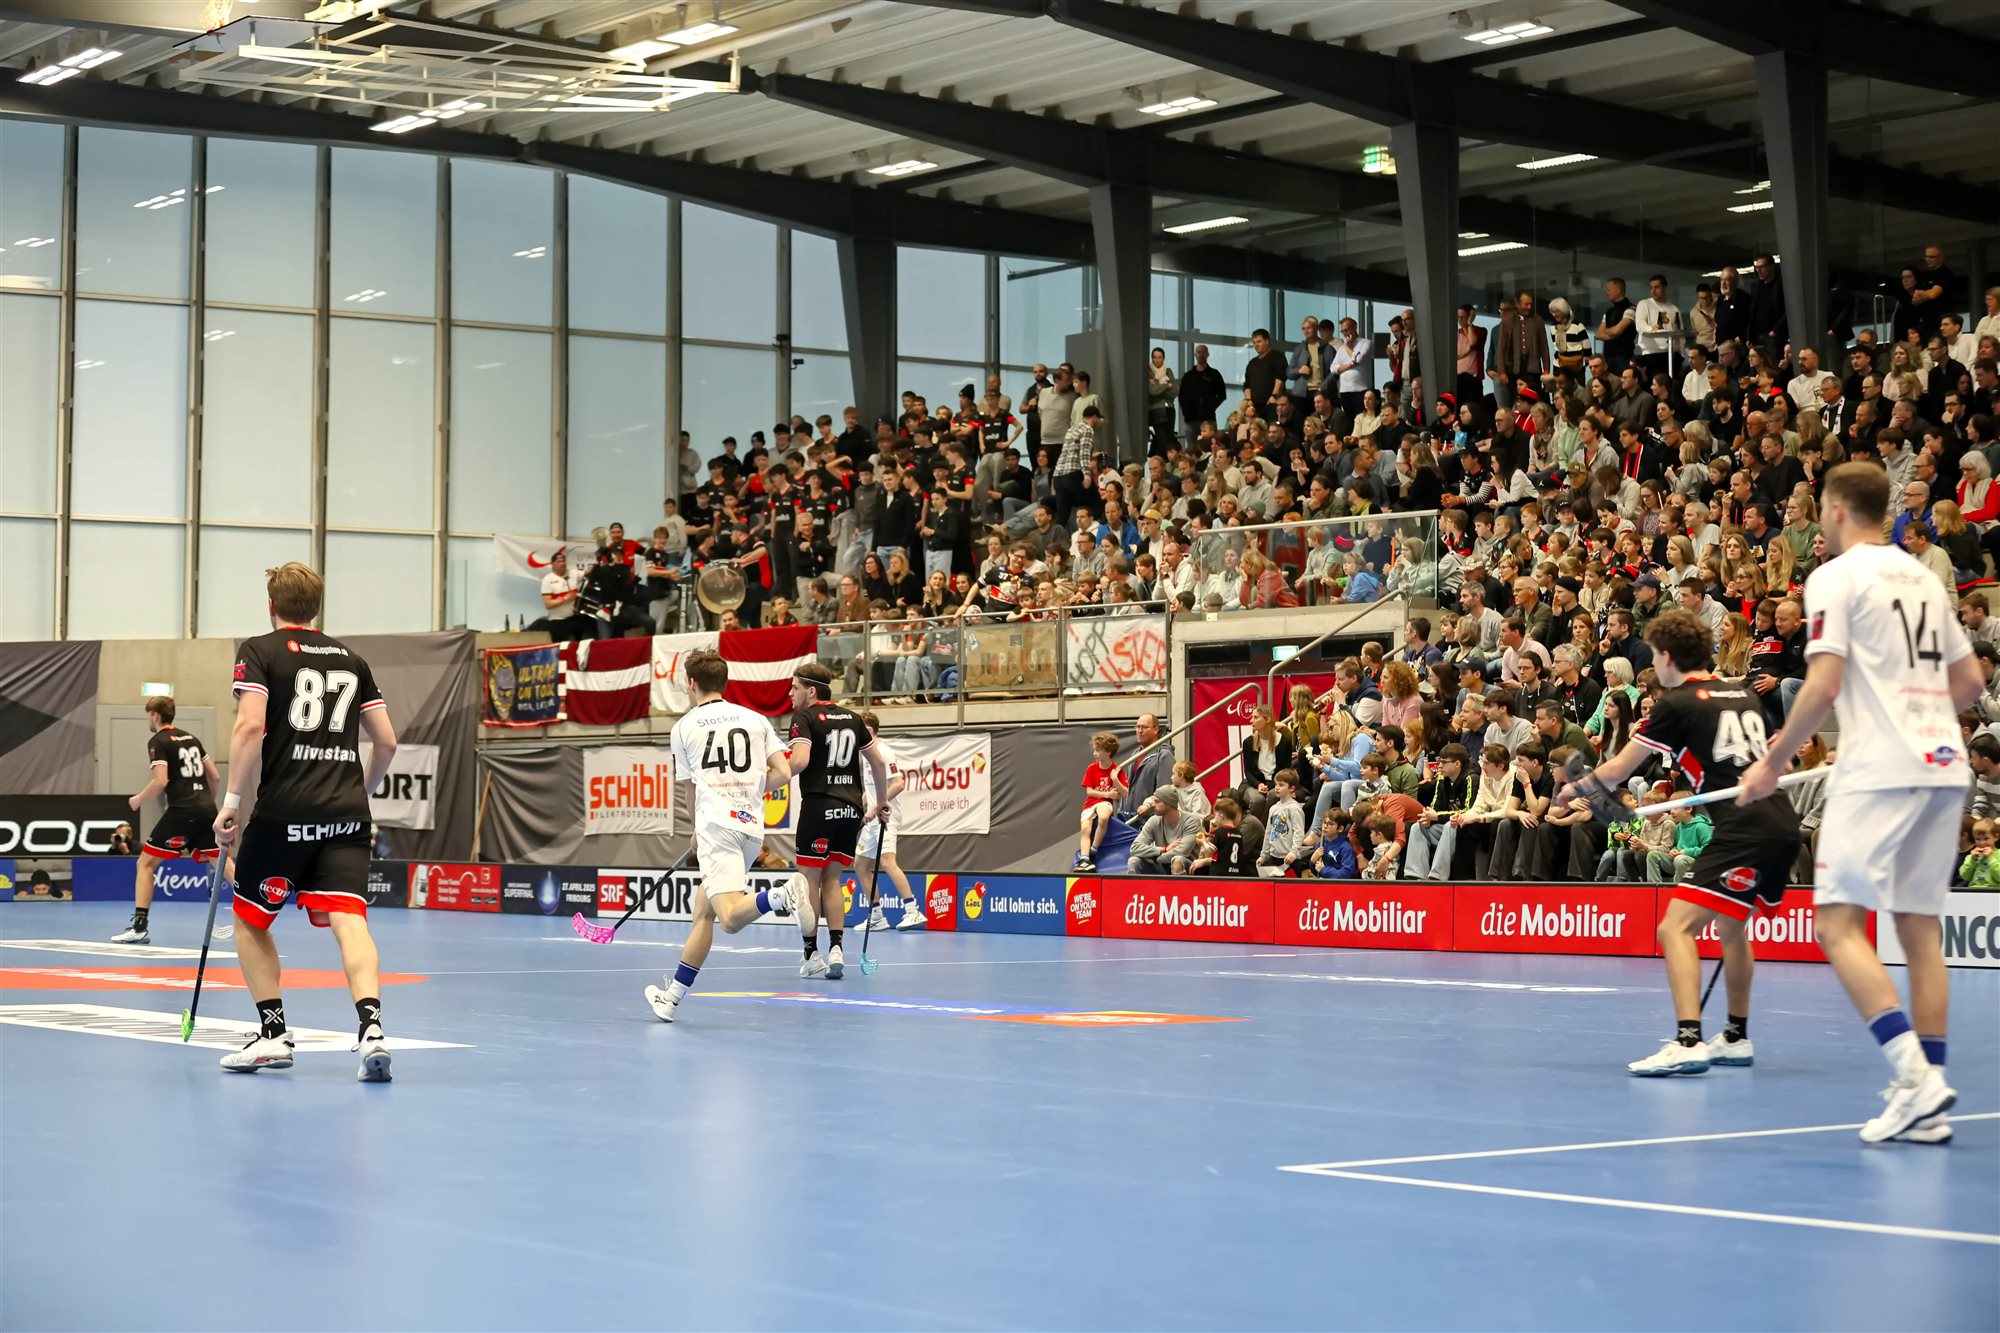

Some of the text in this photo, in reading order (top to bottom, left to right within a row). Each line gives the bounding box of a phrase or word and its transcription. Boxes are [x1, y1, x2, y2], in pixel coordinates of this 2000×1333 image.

[1892, 598, 1944, 672] 14
[288, 667, 359, 733] 87
[701, 728, 752, 774] 40
[825, 728, 857, 768] 10
[1712, 709, 1769, 767] 48
[178, 746, 204, 777] 33
[920, 796, 970, 810] eine wie ich
[600, 883, 624, 903] SRF
[934, 904, 949, 914] TEAM
[990, 896, 1059, 914] Lidl lohnt sich.
[1075, 909, 1092, 919] TEAM
[1125, 894, 1249, 927] die Mobiliar
[1299, 899, 1427, 934] die Mobiliar
[1480, 902, 1627, 938] die Mobiliar
